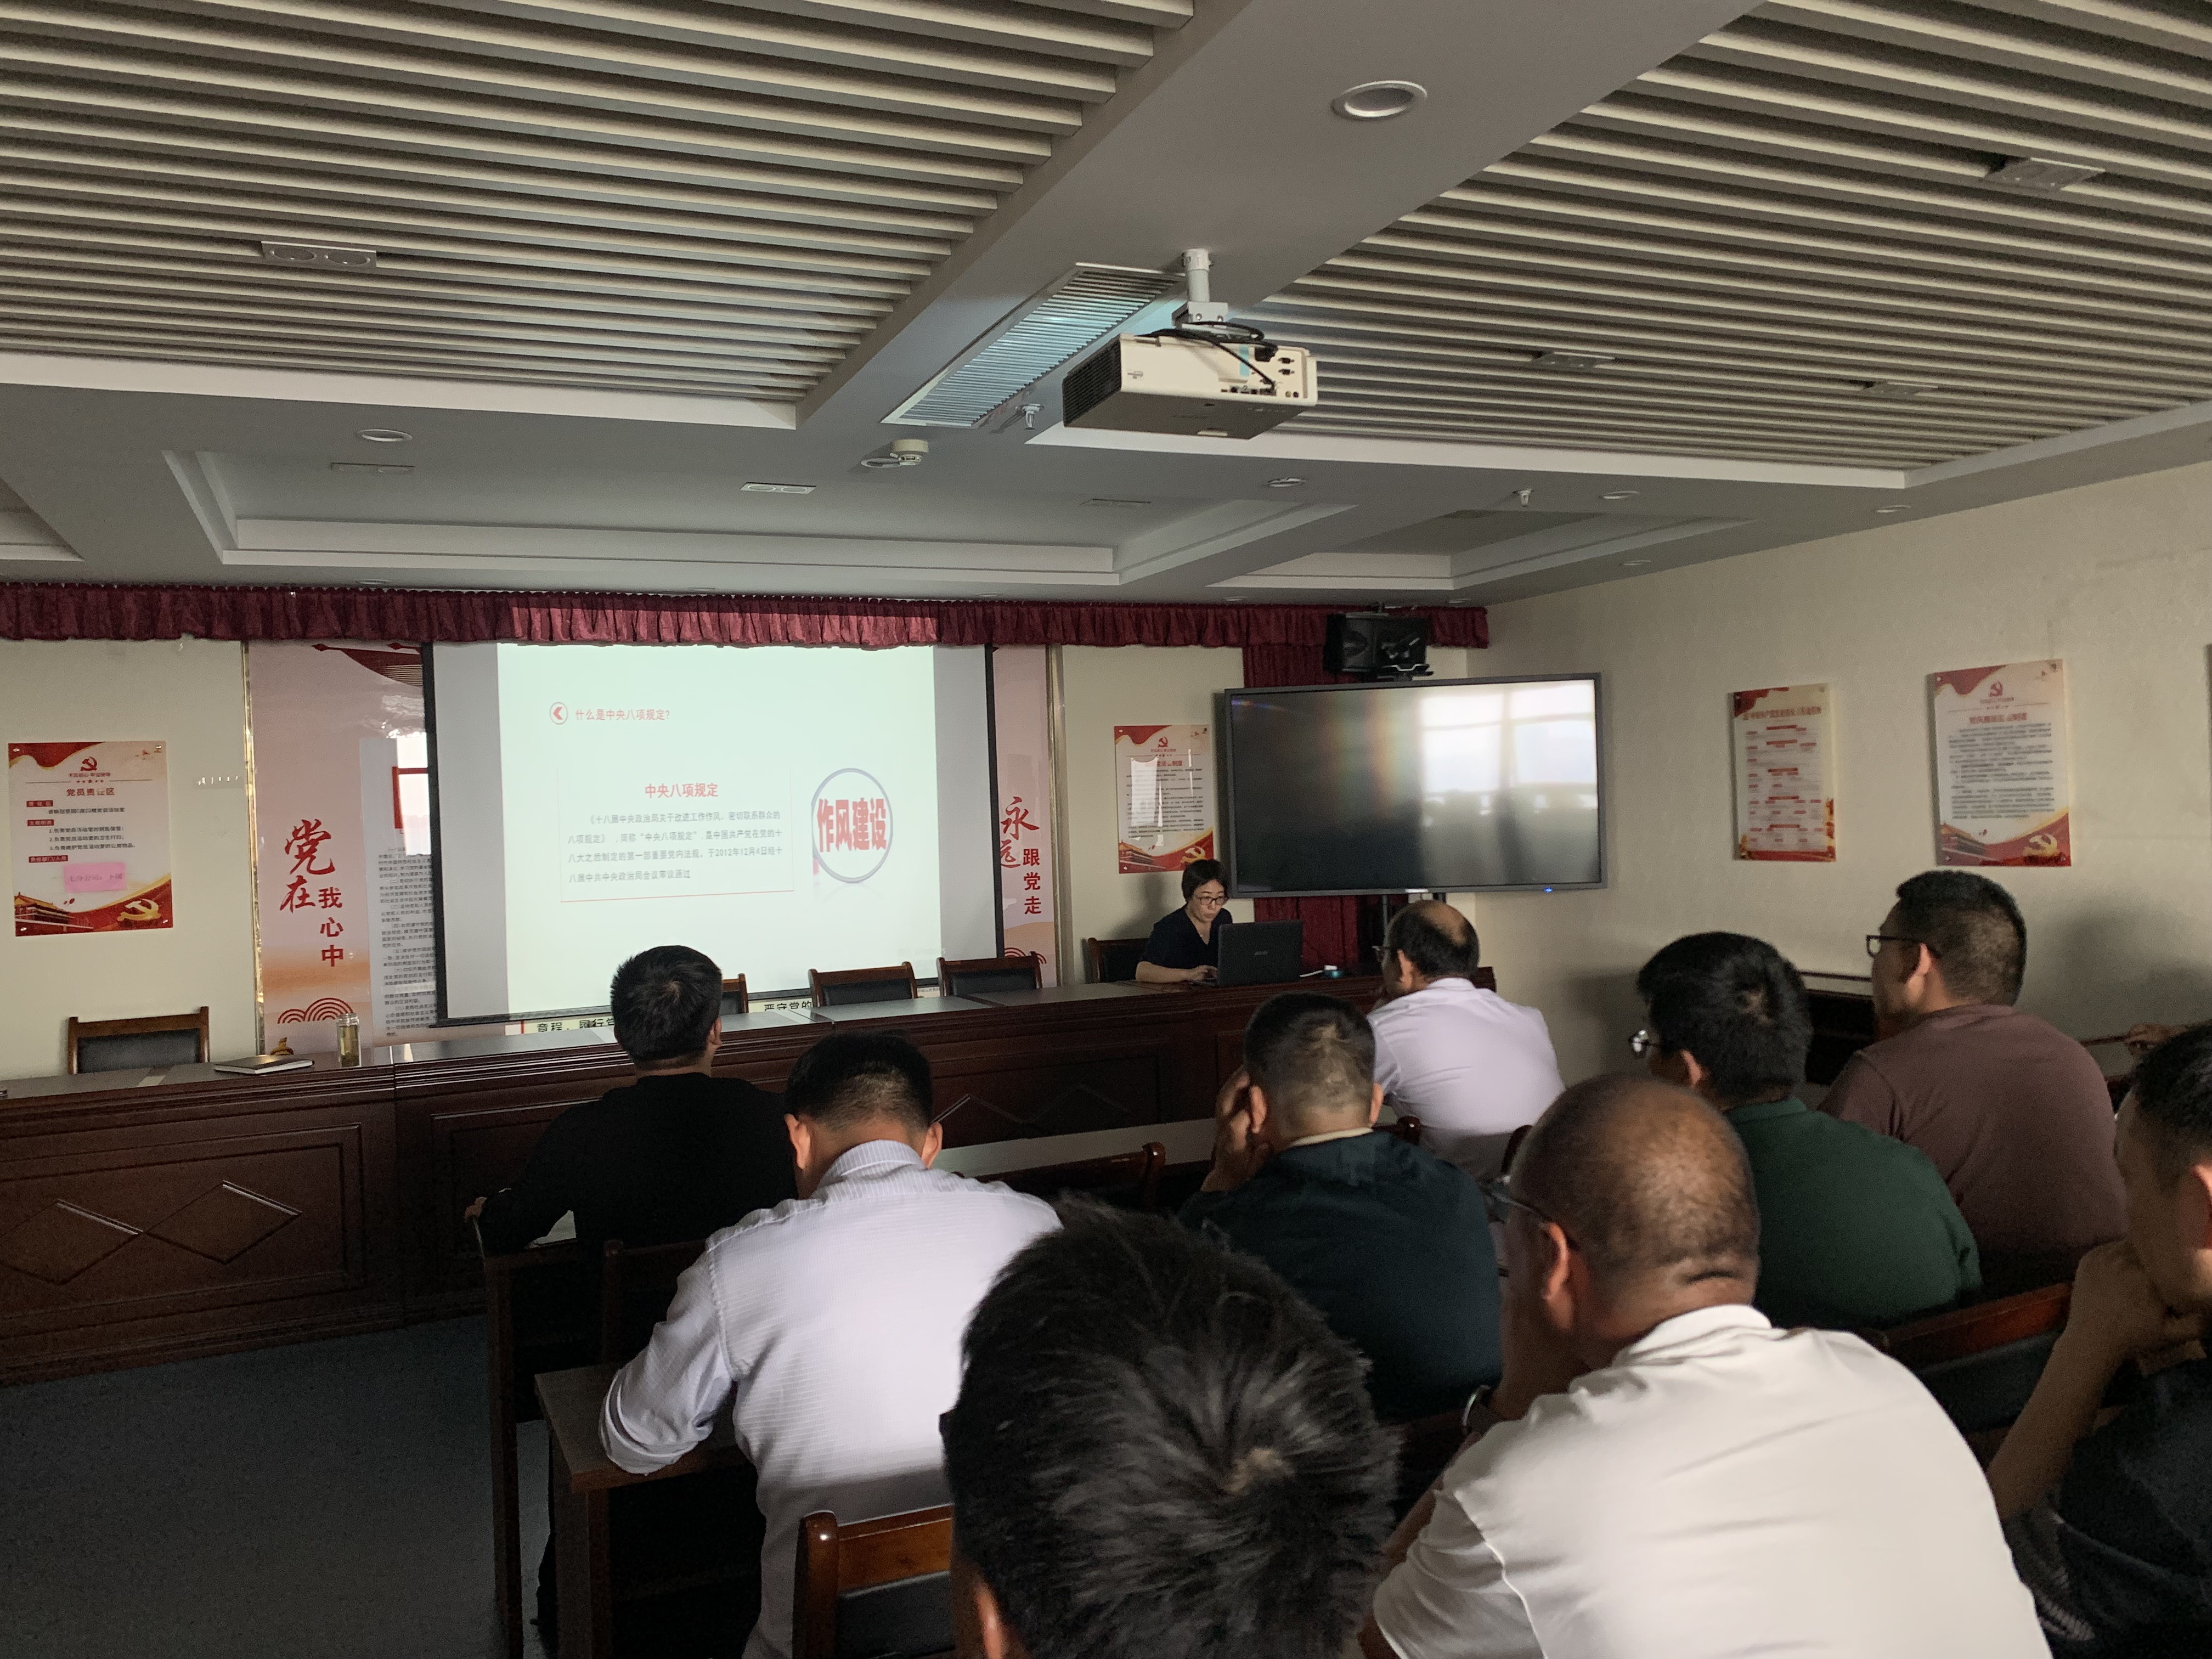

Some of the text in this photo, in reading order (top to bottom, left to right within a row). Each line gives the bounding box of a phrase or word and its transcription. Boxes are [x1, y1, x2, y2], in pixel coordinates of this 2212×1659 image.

[645, 783, 719, 799] 中央八项规定
[817, 797, 887, 853] 作风建设
[569, 869, 691, 883] 八届中共中央政治局会议审议通过
[1022, 848, 1042, 915] 跟党走
[318, 886, 344, 967] 我心中
